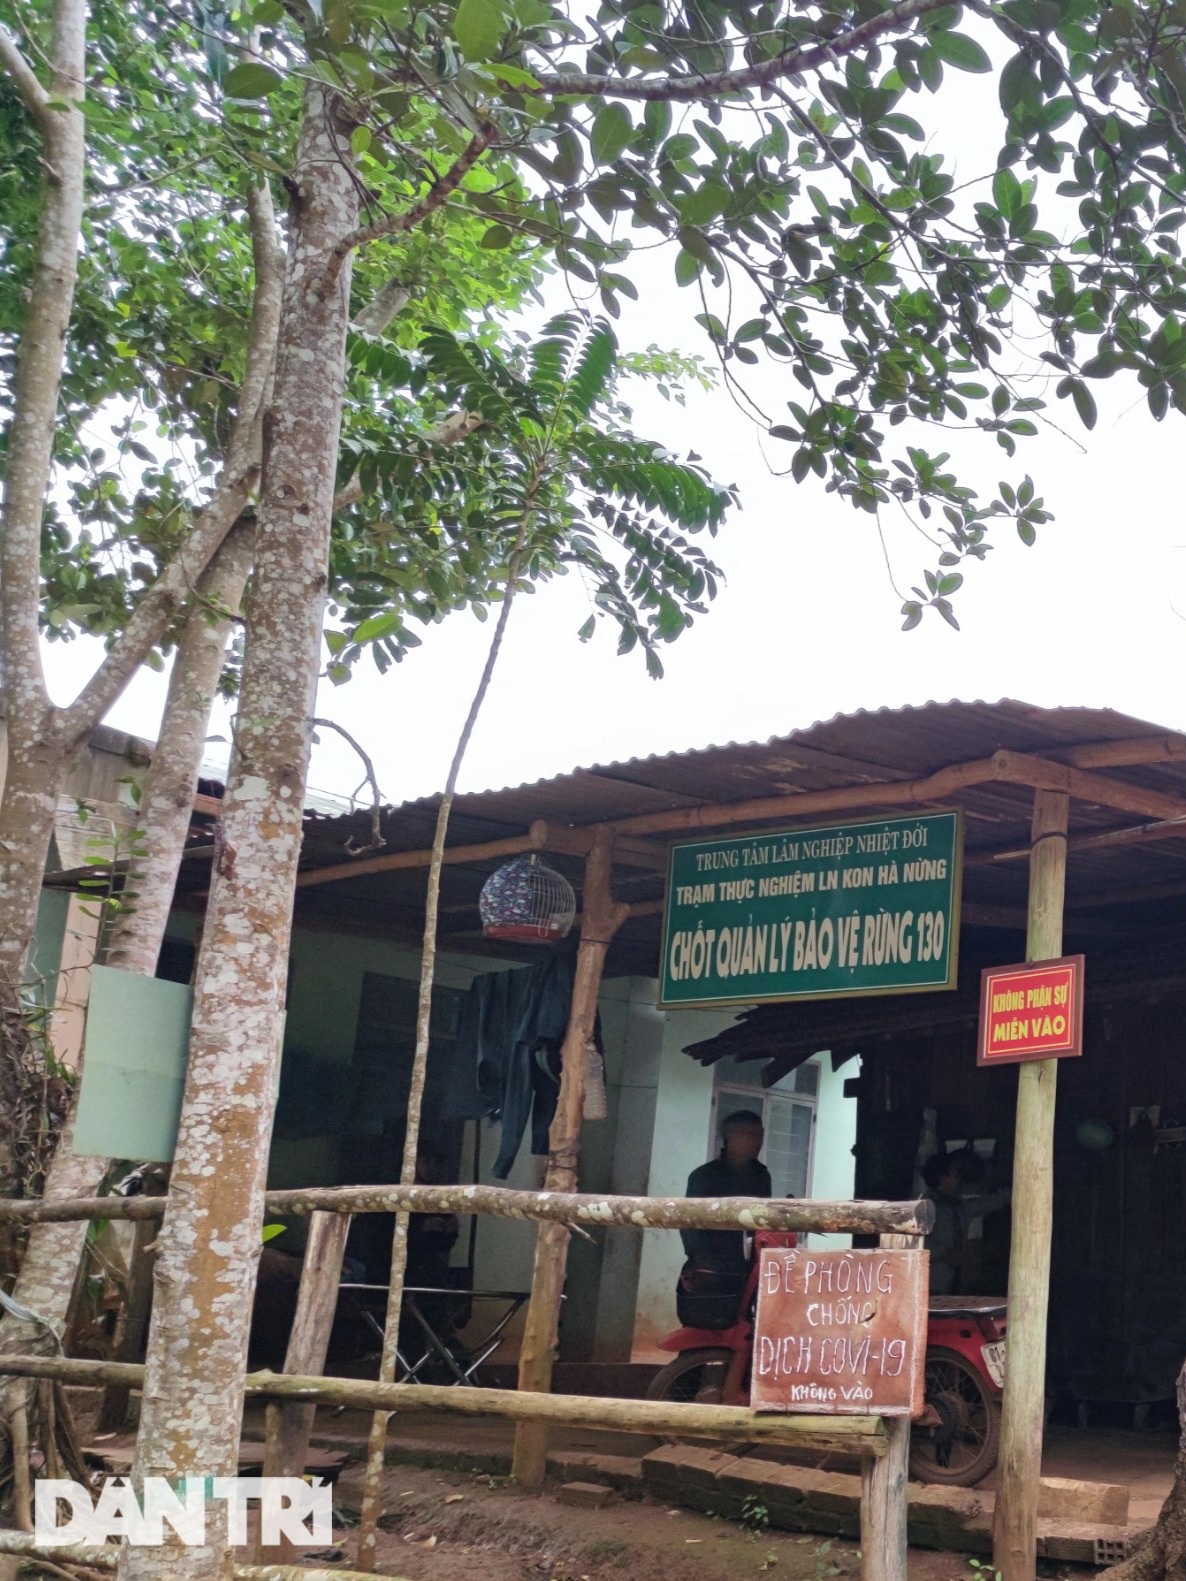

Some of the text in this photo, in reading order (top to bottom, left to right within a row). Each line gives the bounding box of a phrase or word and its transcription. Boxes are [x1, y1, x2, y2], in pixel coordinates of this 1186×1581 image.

[696, 822, 928, 872] TRUNG TÂM LÂM NGHIỆP NHIỆT ĐỚI
[676, 858, 947, 908] TRẠM THỰC NGHIỆM LN KON HÀ NỪNG
[670, 907, 945, 981] CHỐT QUẢN LÝ BẢO VỆ RỪNG 130
[993, 981, 1069, 1013] KHÔNG PHẬN SỰ
[1031, 1015, 1066, 1038] VÀO
[764, 1249, 894, 1295] ĐỀ PHÒNG
[806, 1296, 875, 1328] CHỐNG
[759, 1336, 812, 1381] DỊCH
[791, 1381, 873, 1402] KHÔNG VÀO
